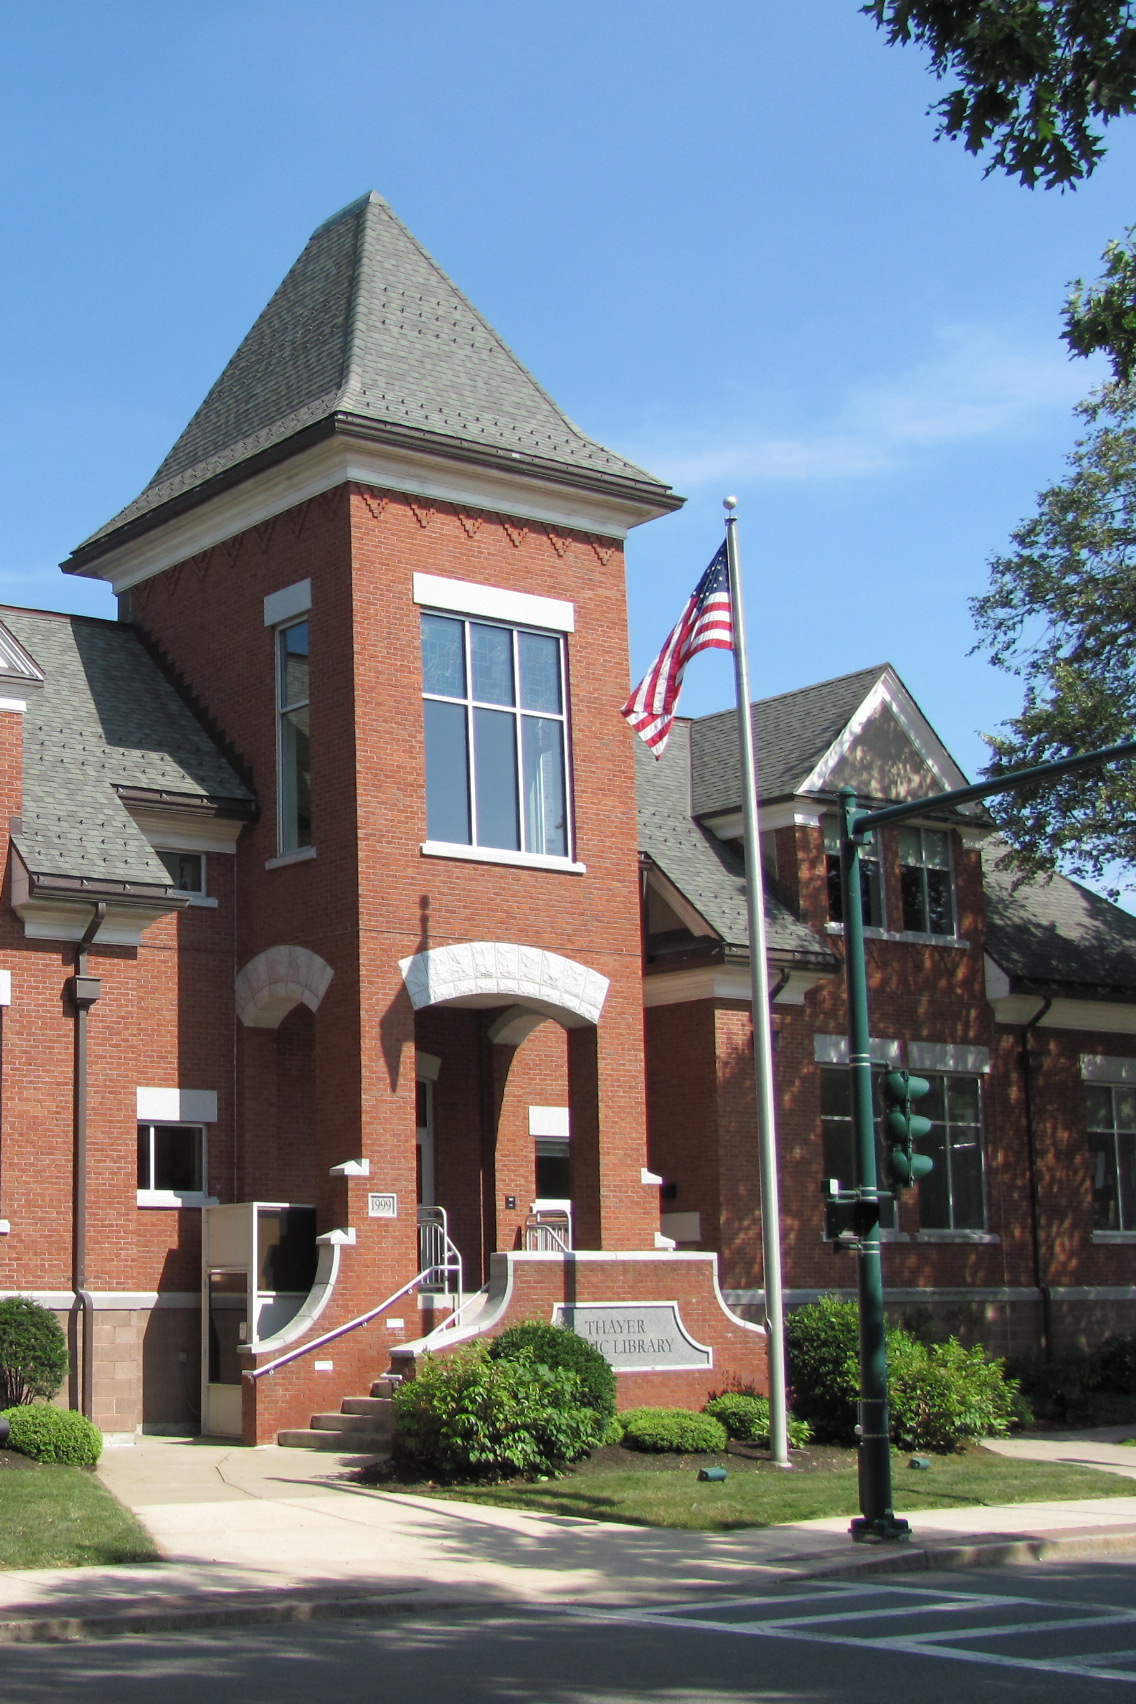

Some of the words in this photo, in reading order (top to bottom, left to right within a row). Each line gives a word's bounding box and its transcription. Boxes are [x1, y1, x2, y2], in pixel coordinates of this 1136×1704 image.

[371, 1199, 392, 1211] 1999
[584, 1319, 646, 1335] THAYER
[613, 1338, 674, 1354] LIBRARY
